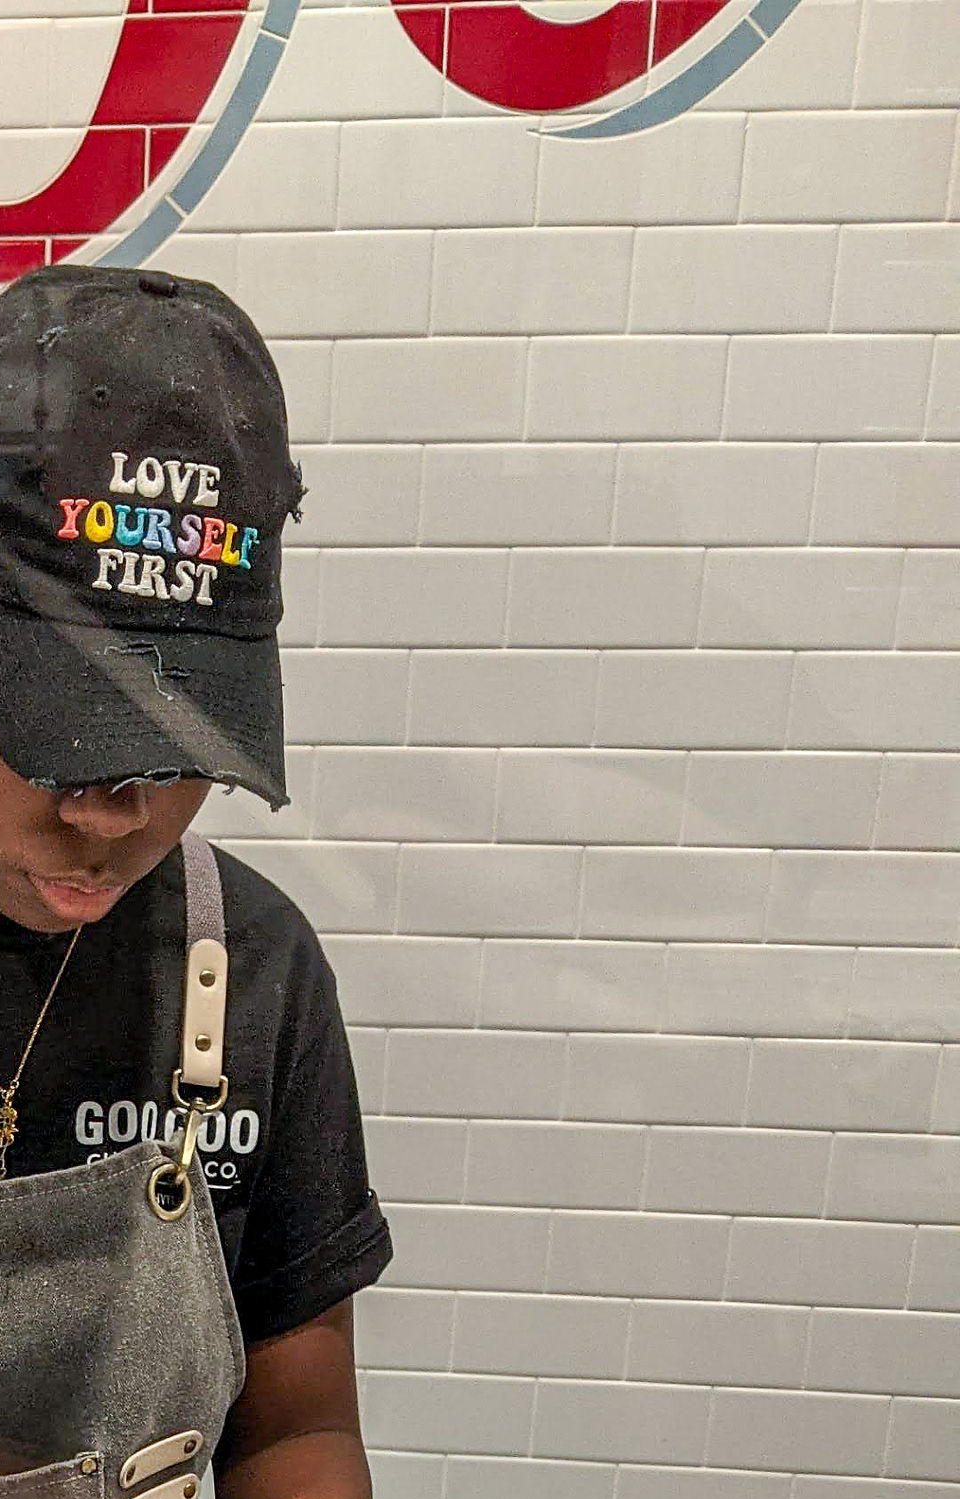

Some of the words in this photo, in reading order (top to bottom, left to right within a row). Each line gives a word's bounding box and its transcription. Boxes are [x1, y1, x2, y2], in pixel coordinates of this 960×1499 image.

[109, 452, 221, 507] LOVE
[57, 498, 260, 570] YOURSELF
[92, 549, 218, 606] FIRST
